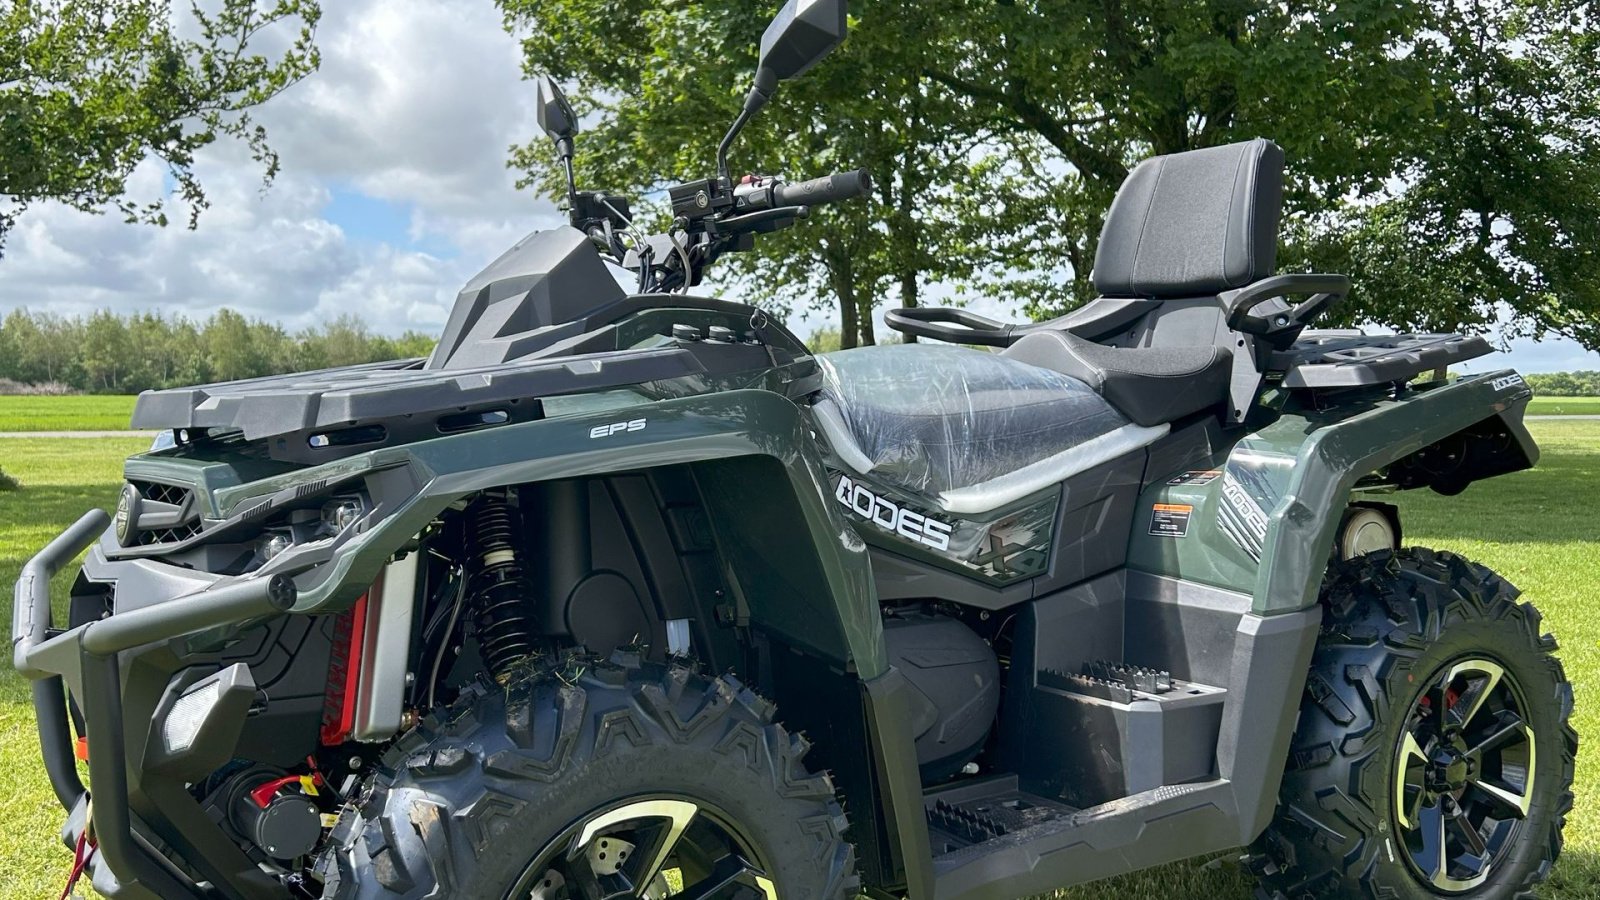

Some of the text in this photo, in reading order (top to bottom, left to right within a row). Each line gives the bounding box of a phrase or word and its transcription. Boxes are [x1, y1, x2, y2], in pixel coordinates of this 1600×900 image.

[590, 418, 646, 438] EPS
[836, 475, 952, 552] AODES
[1224, 485, 1268, 539] AODES
